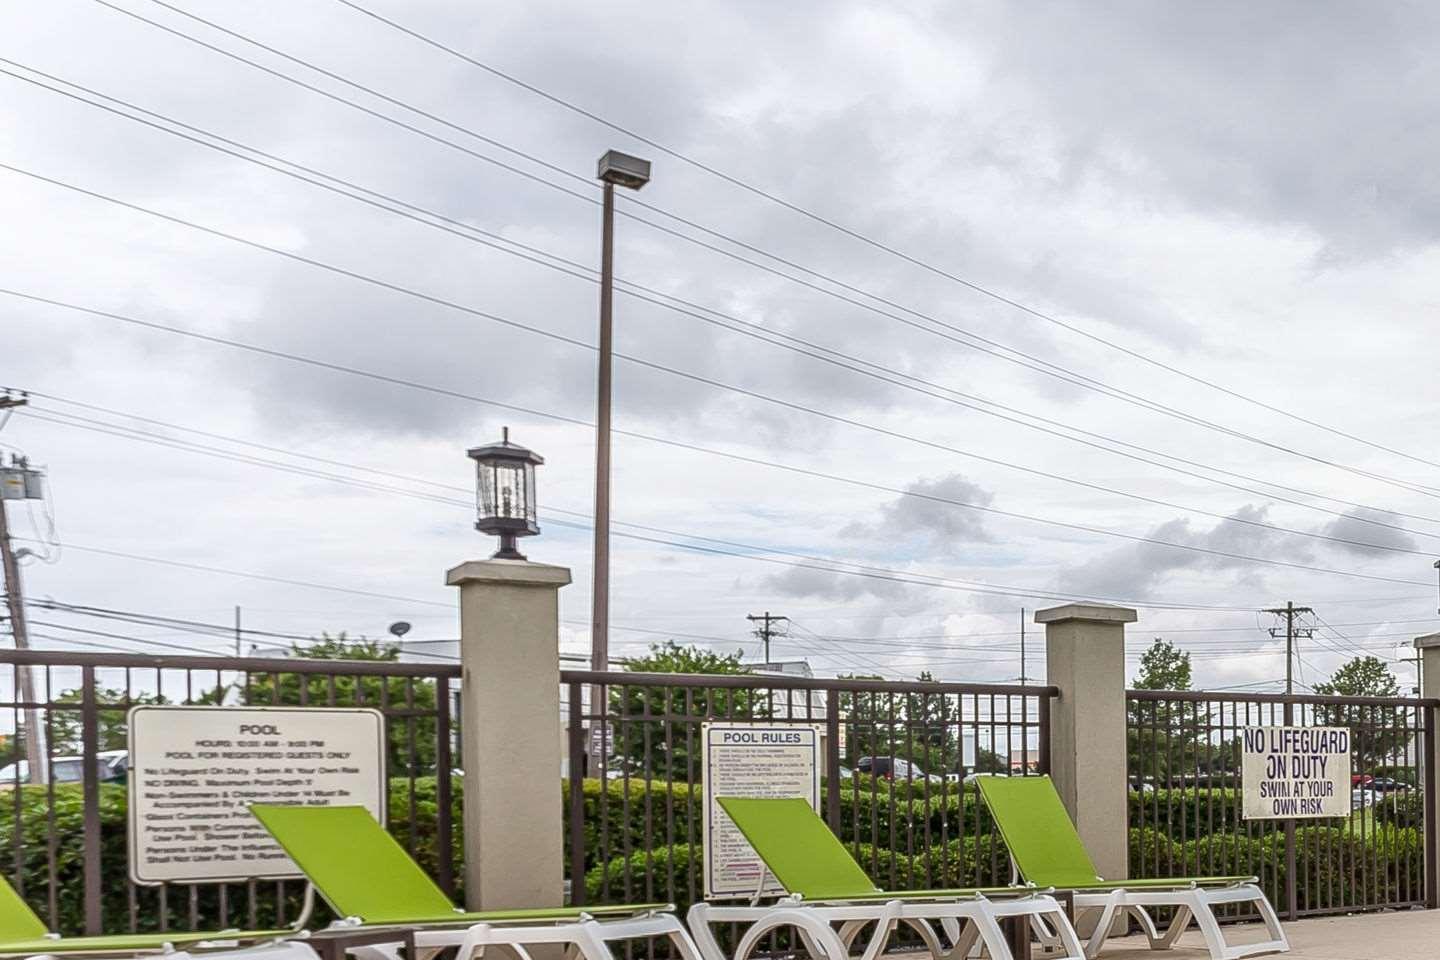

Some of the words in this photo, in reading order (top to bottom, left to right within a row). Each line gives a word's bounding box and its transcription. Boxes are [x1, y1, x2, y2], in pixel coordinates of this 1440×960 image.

[240, 725, 280, 735] POOL
[723, 733, 758, 743] POOL
[761, 733, 801, 743] RULES
[1245, 728, 1265, 753] NO
[1271, 730, 1348, 754] LIFEGUARD
[1267, 756, 1287, 779] ON
[1292, 756, 1328, 779] DUTY
[1260, 781, 1291, 798] SWIM
[1293, 782, 1305, 797] AT
[1307, 781, 1334, 797] YOUR
[1273, 799, 1297, 815] OWN
[1300, 798, 1323, 815] RISK
